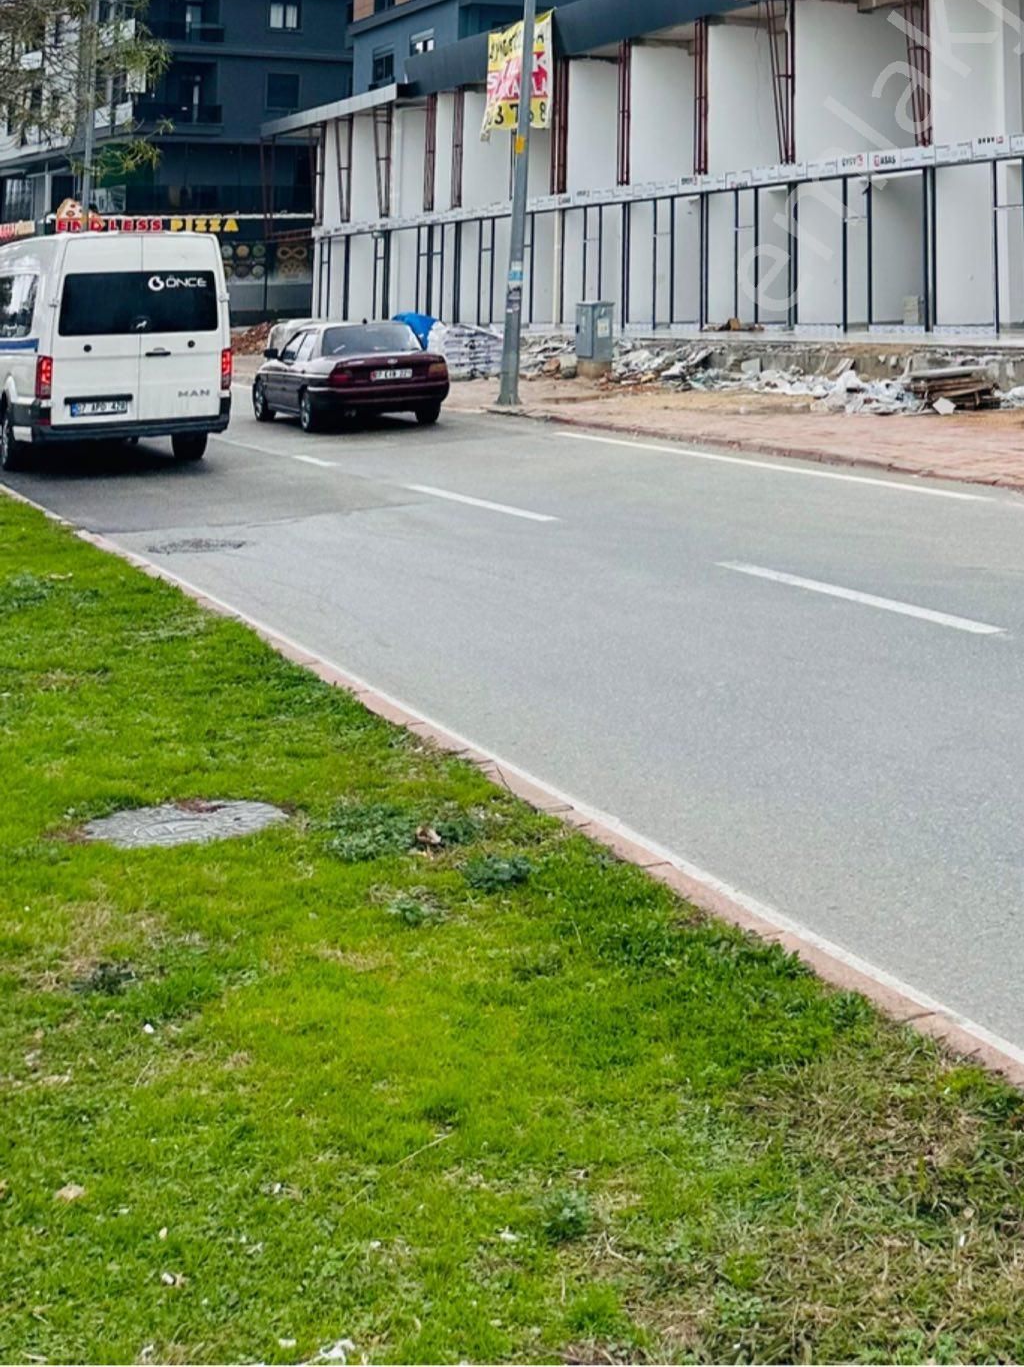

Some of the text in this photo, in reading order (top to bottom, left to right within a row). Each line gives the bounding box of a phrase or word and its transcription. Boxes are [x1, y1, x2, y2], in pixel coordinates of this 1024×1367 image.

[56, 217, 239, 232] ENDLESS PIZZA
[166, 274, 207, 288] ÖNCE
[178, 389, 210, 398] MAN
